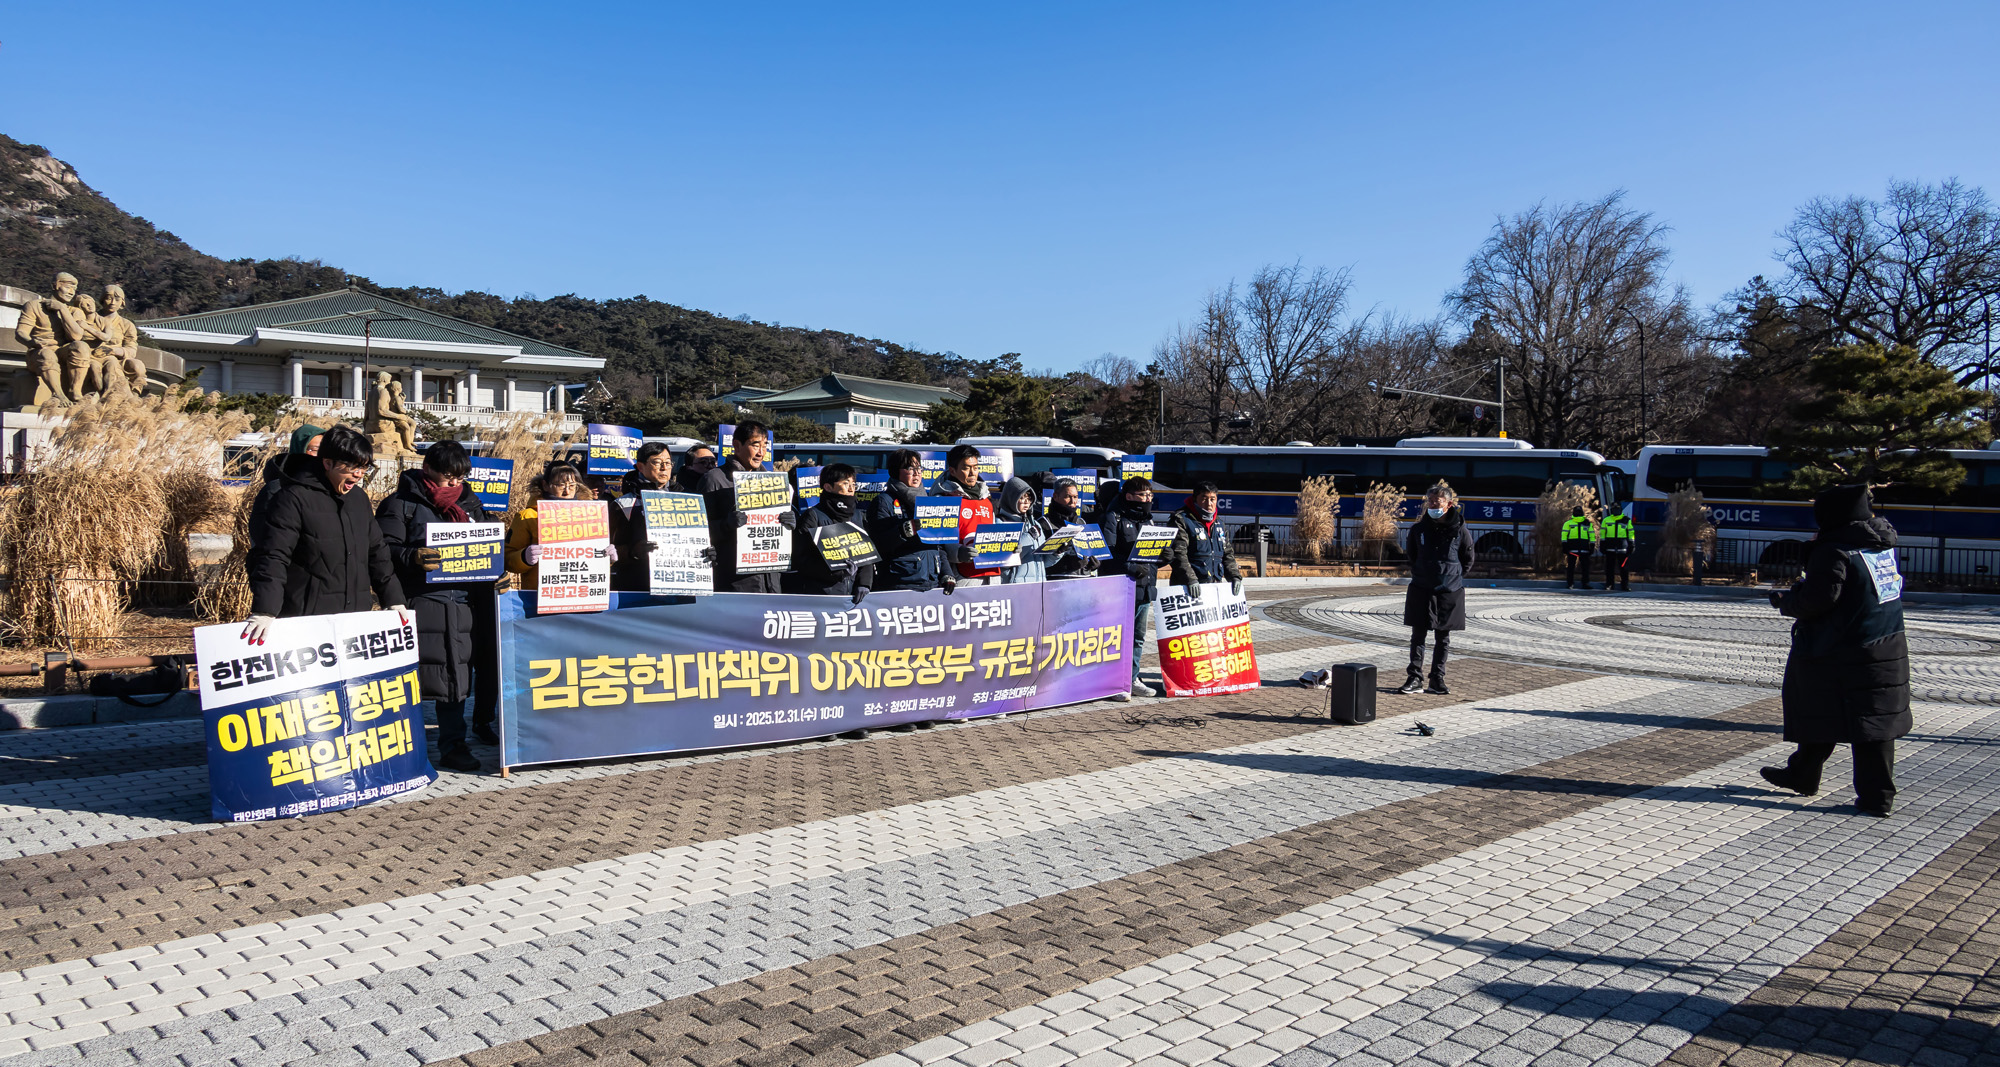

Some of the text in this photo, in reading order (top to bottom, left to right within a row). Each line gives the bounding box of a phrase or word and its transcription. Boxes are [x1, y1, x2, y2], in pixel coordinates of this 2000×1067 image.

[468, 467, 511, 482] 비정규직
[486, 482, 509, 494] 이행!
[736, 475, 786, 494] 김충현의
[645, 497, 701, 512] 김용균의
[738, 491, 791, 509] 외침이다!
[540, 504, 602, 525] 김충현의
[648, 512, 709, 527] 외침이다!
[916, 505, 960, 517] 발전비정규직
[431, 527, 500, 542] 한전KPS 직접고용
[541, 521, 608, 542] 외침이다!
[747, 526, 783, 538] 경상정비
[821, 531, 864, 549] 진상규명!
[468, 542, 501, 557] 정부가
[752, 539, 780, 551] 노동자
[823, 541, 874, 560] 책임자 처벌!
[442, 557, 492, 573] 책임져라!
[559, 561, 589, 572] 발전소
[541, 573, 606, 585] 비정규직 노동자
[541, 585, 607, 599] 직접고용하라!
[763, 598, 1012, 640] 해를 넘긴 위험의 외주화!
[1168, 630, 1225, 661] 위험의
[210, 625, 415, 692] 한전KPS 직접고용
[529, 624, 1123, 711] 김충현대책위 이재명정부 규탄 기자회견
[1192, 649, 1253, 683] 중단하라!
[217, 669, 421, 753] 이재명 정부가
[713, 713, 738, 729] 일시
[745, 707, 817, 726] 2025.12.31.(수)
[820, 705, 844, 720] 10:00
[864, 703, 883, 716] 장소
[890, 699, 918, 715] 청와대
[918, 697, 946, 711] 분수대
[946, 695, 956, 707] 앞
[972, 691, 989, 704] 주최
[267, 717, 414, 787] 책임져라!
[233, 806, 277, 822] 태안화력
[320, 792, 357, 809] 비정규직
[357, 786, 379, 801] 노동자
